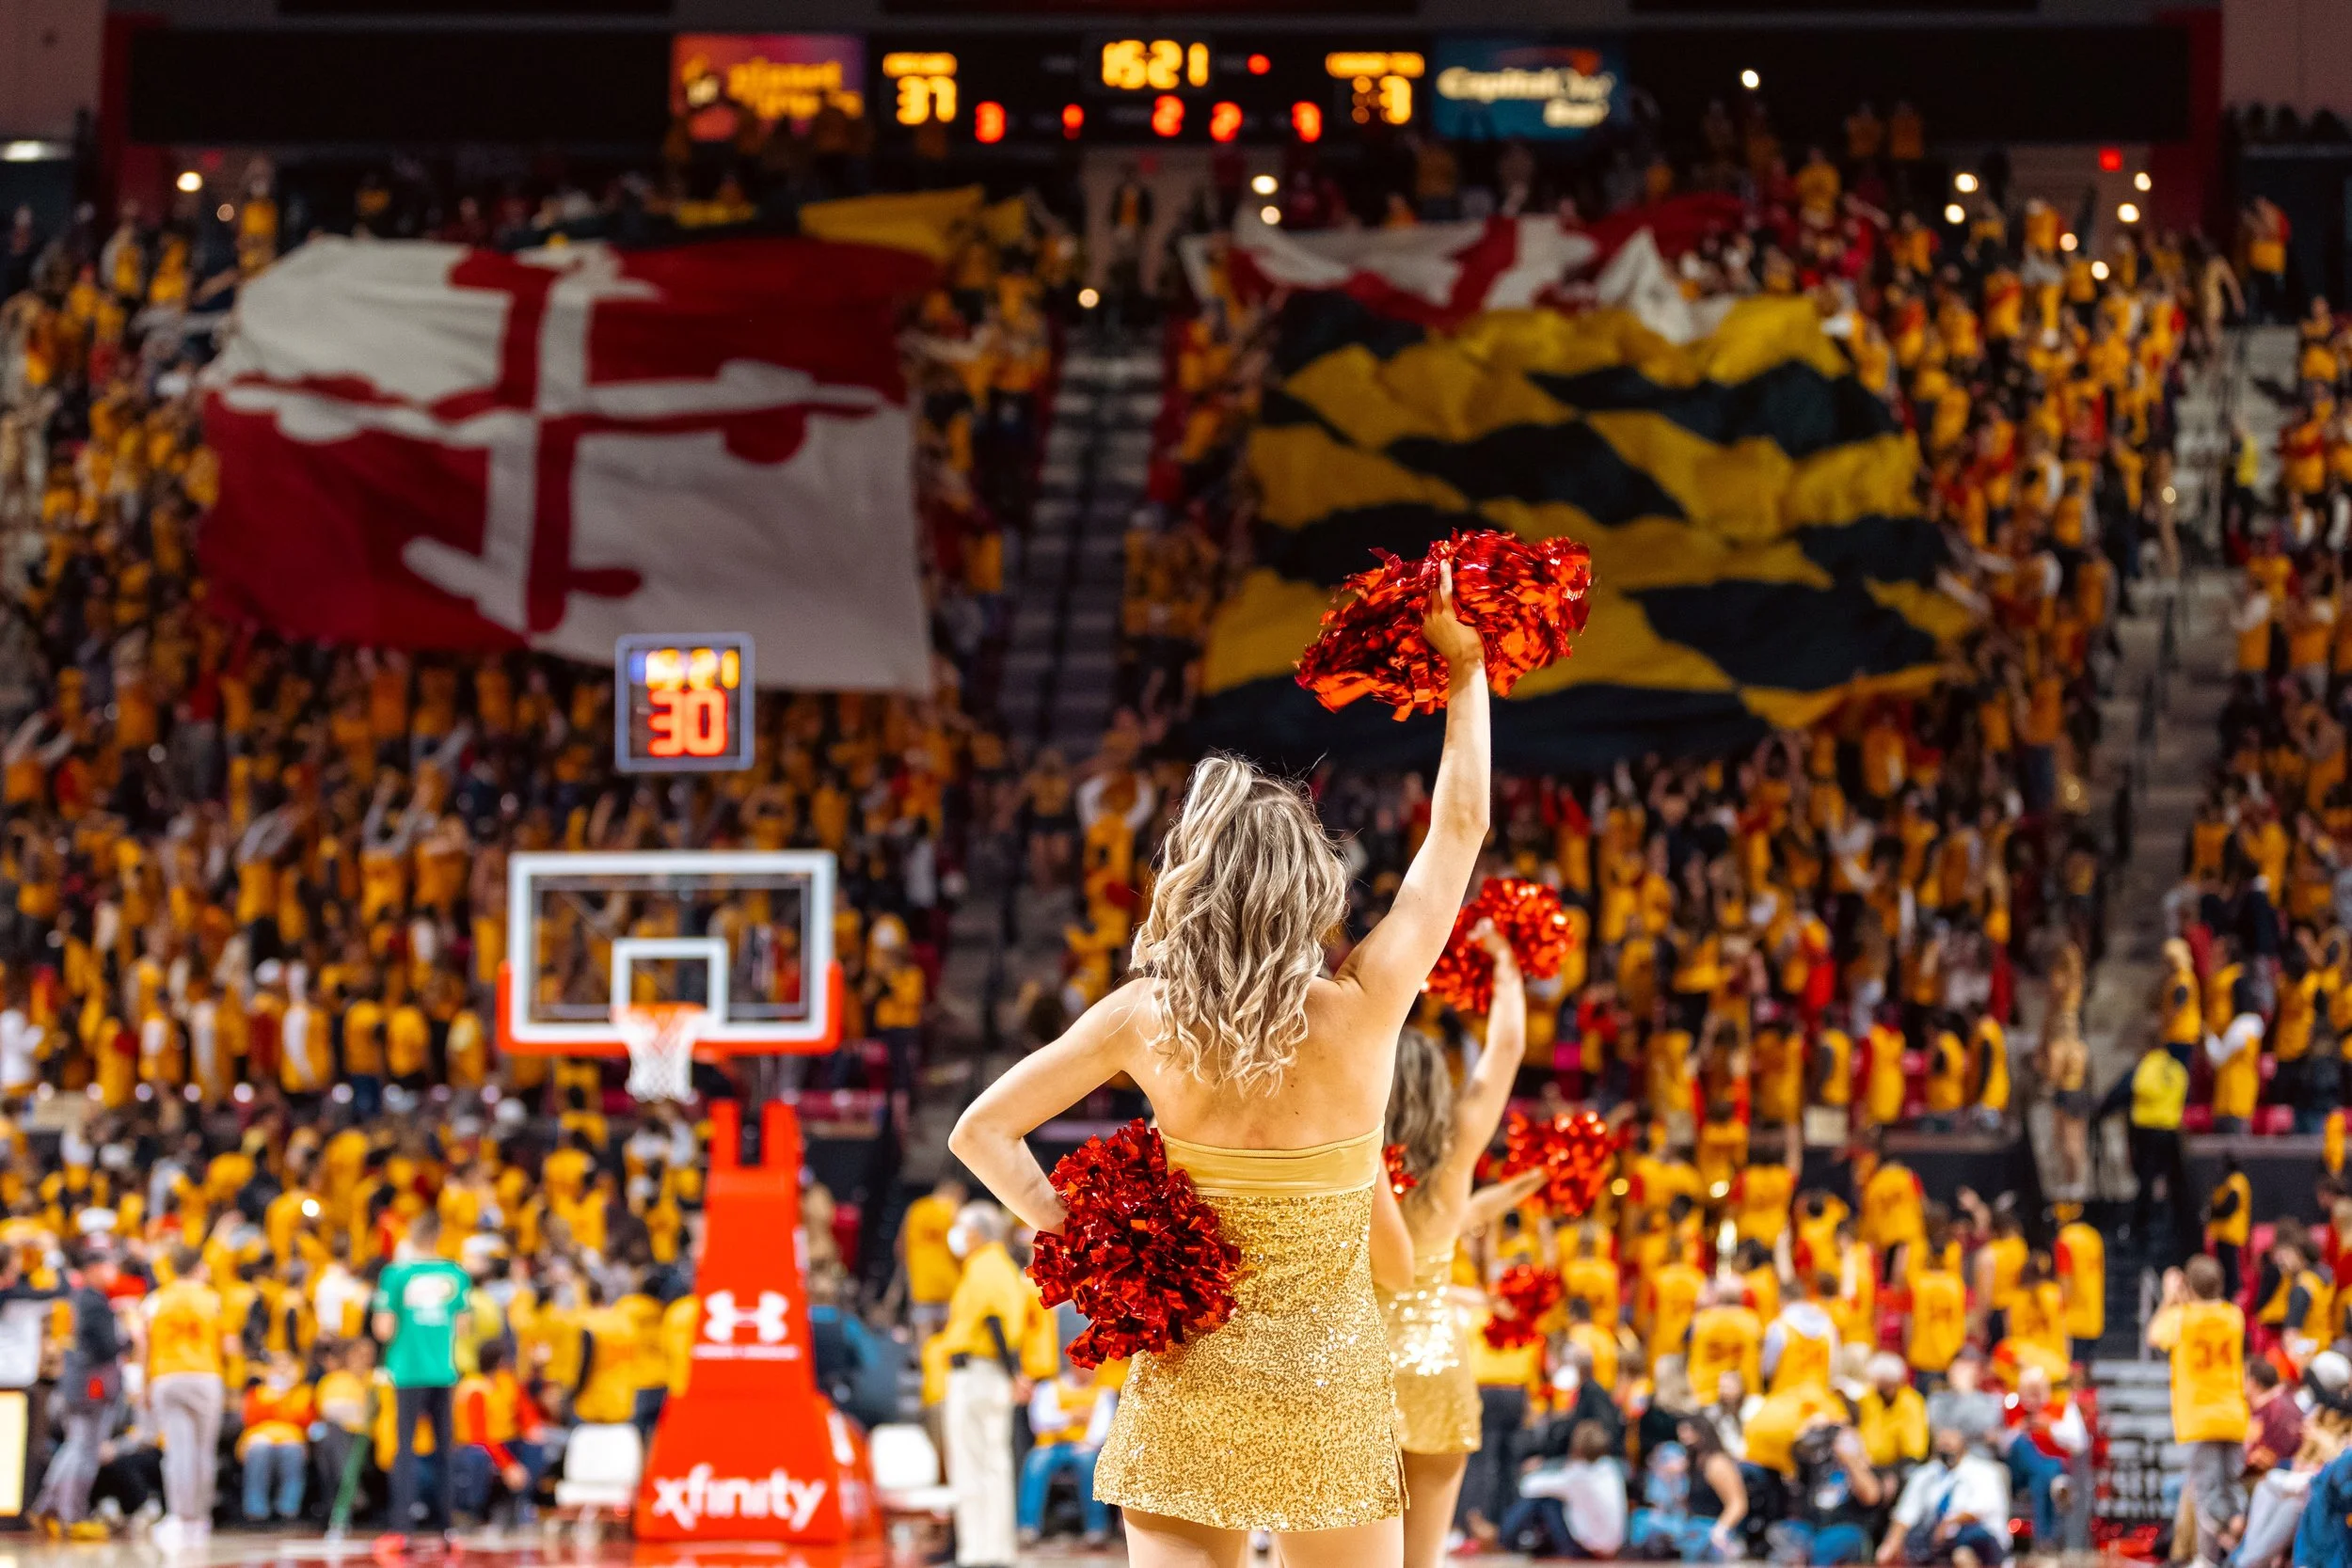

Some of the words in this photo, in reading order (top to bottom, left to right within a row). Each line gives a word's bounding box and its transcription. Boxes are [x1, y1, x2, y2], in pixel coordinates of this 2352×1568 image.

[647, 688, 728, 758] 30
[2193, 1338, 2233, 1371] 34
[651, 1462, 828, 1531] xfinity
